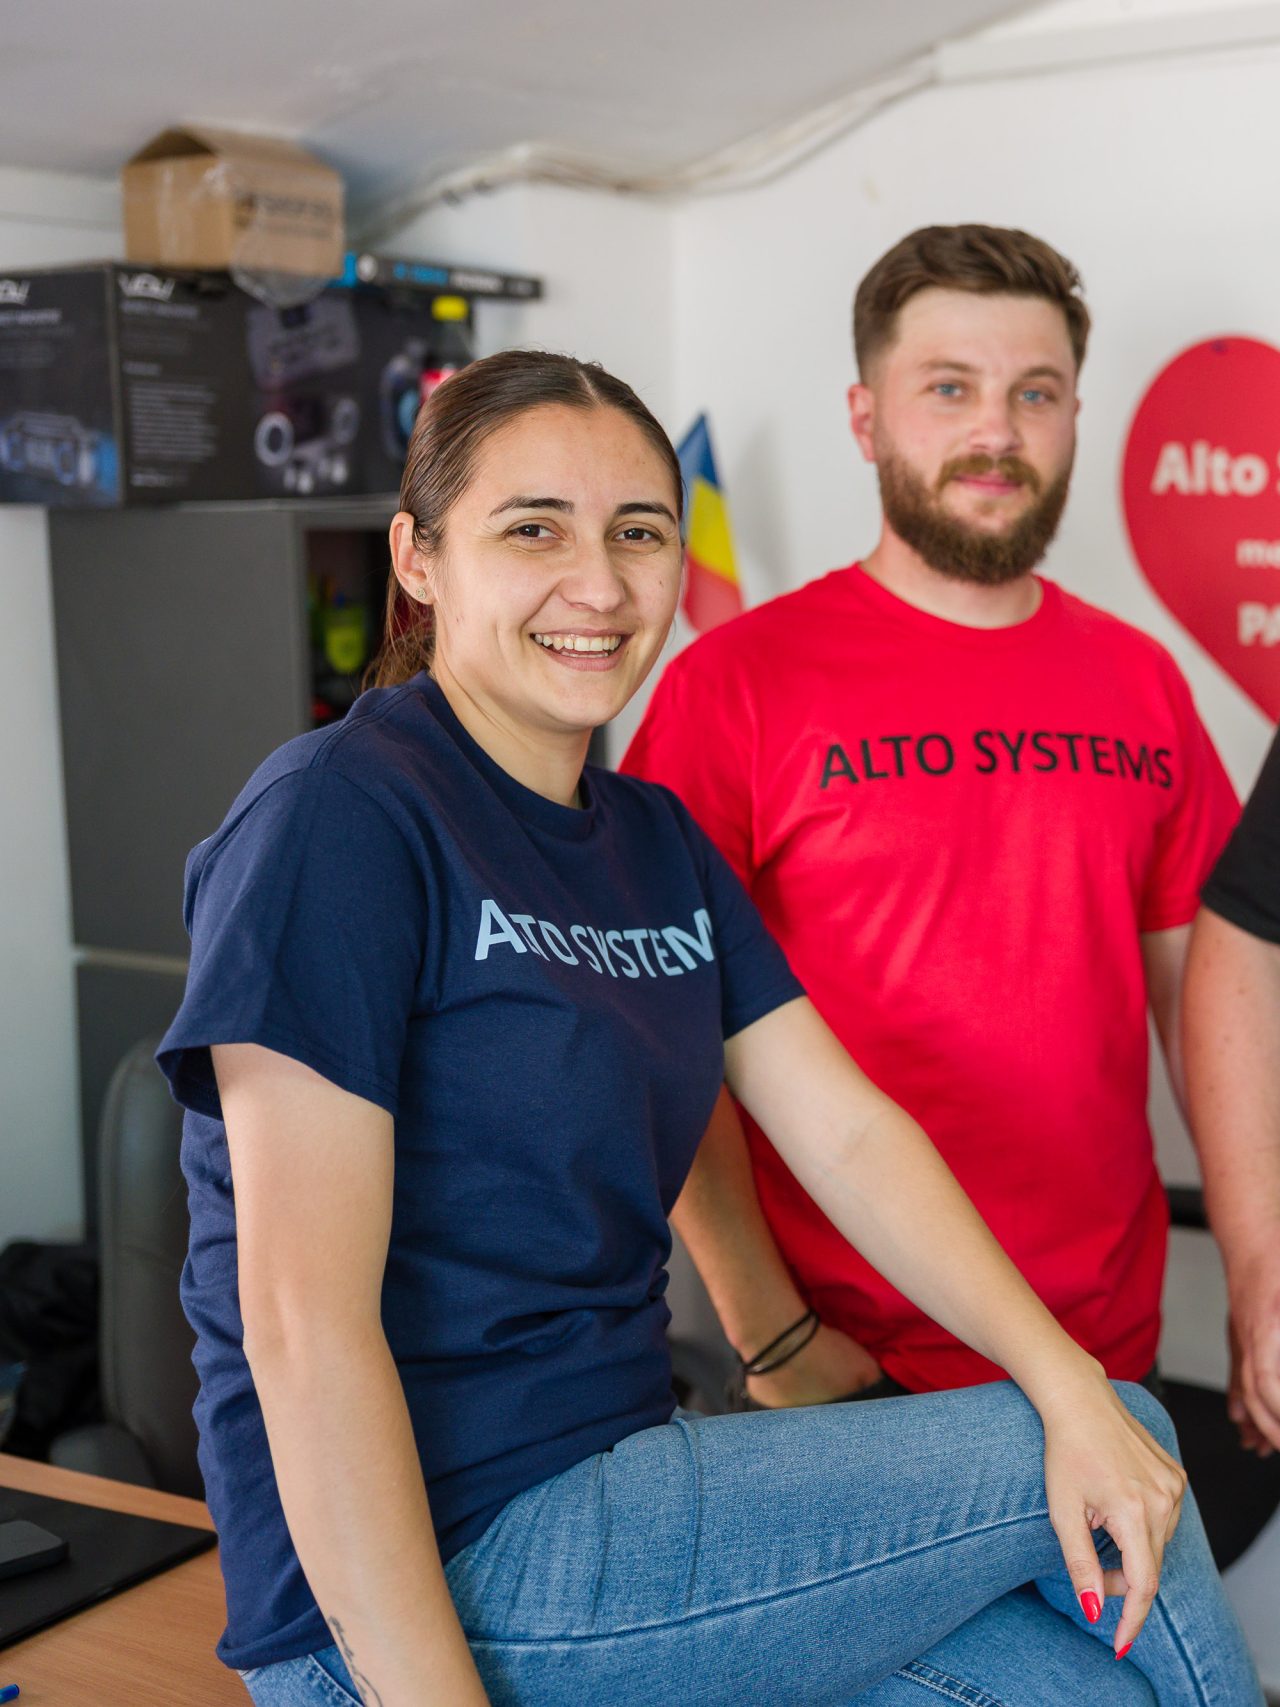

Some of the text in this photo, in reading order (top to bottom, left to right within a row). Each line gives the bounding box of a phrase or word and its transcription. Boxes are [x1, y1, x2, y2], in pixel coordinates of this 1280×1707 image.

[1152, 441, 1269, 496] Alto
[819, 730, 1174, 790] ALTO SYSTEMS
